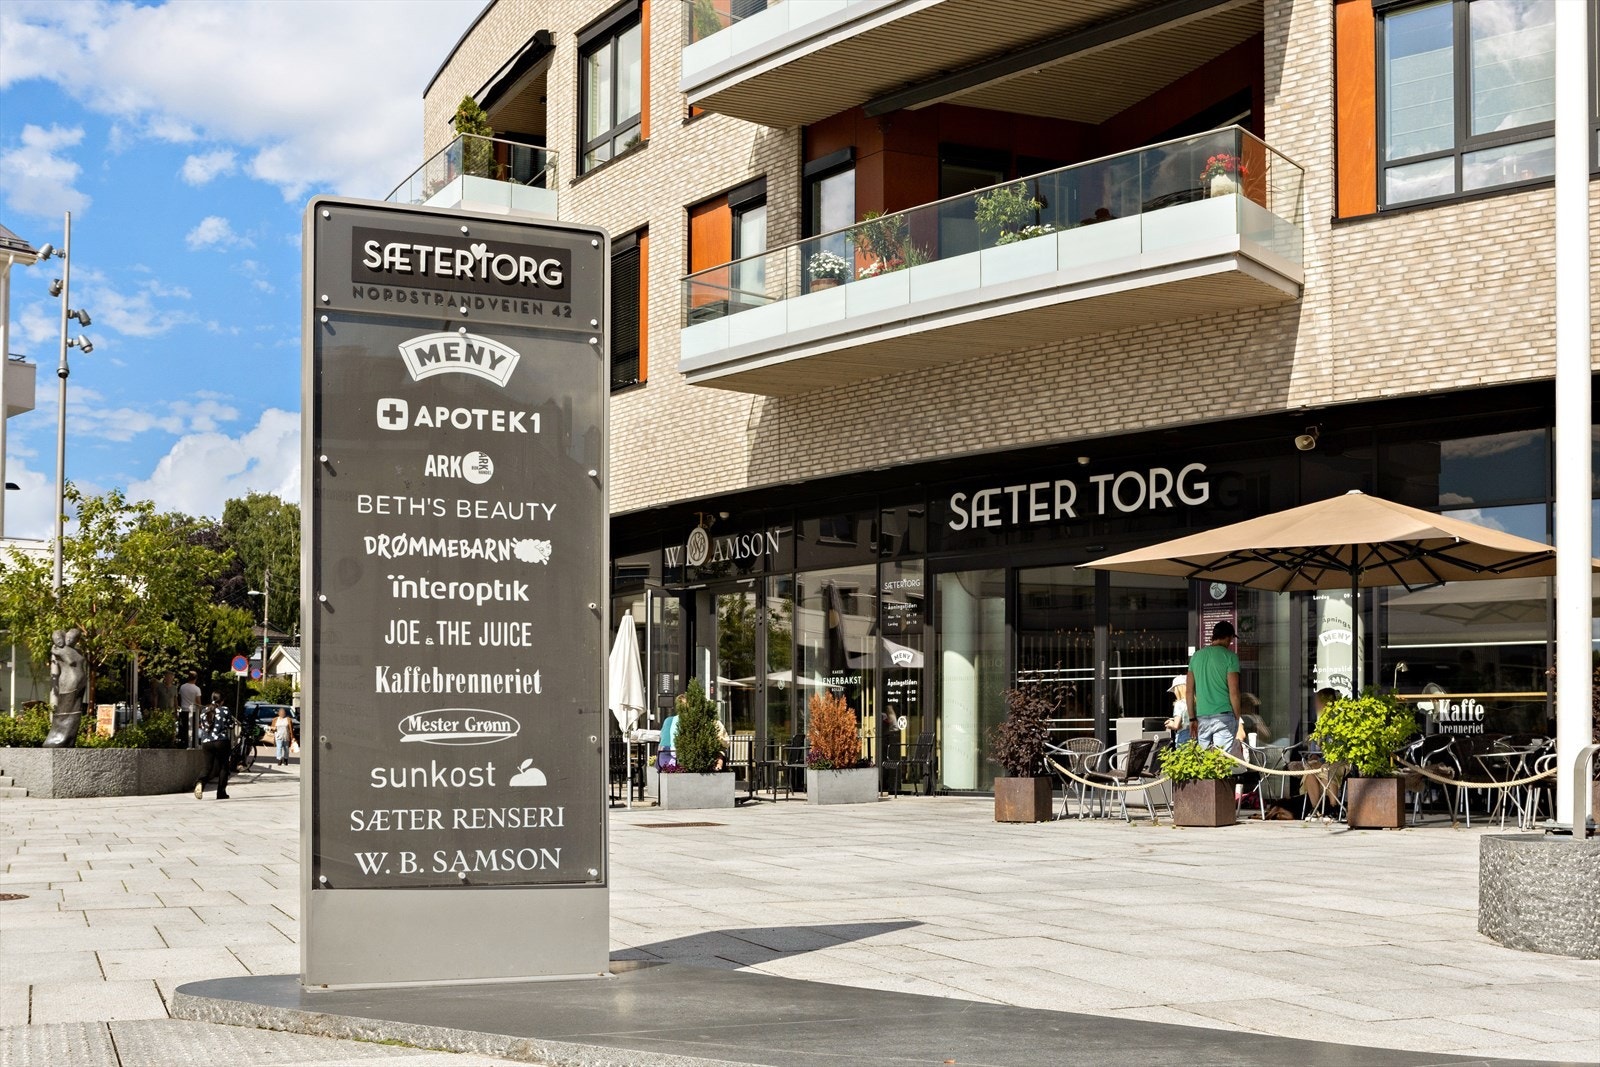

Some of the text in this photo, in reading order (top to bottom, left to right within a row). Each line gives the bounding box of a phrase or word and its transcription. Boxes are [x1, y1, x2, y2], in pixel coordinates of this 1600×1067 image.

[352, 286, 573, 319] NORDSTRANDVEIEN 42
[414, 341, 507, 372] MENY
[424, 454, 463, 479] ARK
[357, 494, 557, 521] BETH'S BEAUTY
[949, 462, 1210, 531] SÆTER TORG
[363, 533, 511, 563] DRØMMEBARN
[711, 530, 781, 563] AMSON
[384, 619, 533, 647] JOE & THE JUICE
[1322, 632, 1351, 642] MENY
[893, 652, 911, 661] MENY
[375, 665, 542, 695] Kaffebrenneriet
[1438, 698, 1485, 722] Kaffe
[408, 716, 511, 733] Mester Grønn
[1438, 722, 1484, 734] brenneriet
[370, 760, 496, 788] sunkost
[350, 806, 565, 832] SÆTER RENSERI
[354, 848, 562, 875] W. B. SAMSON
